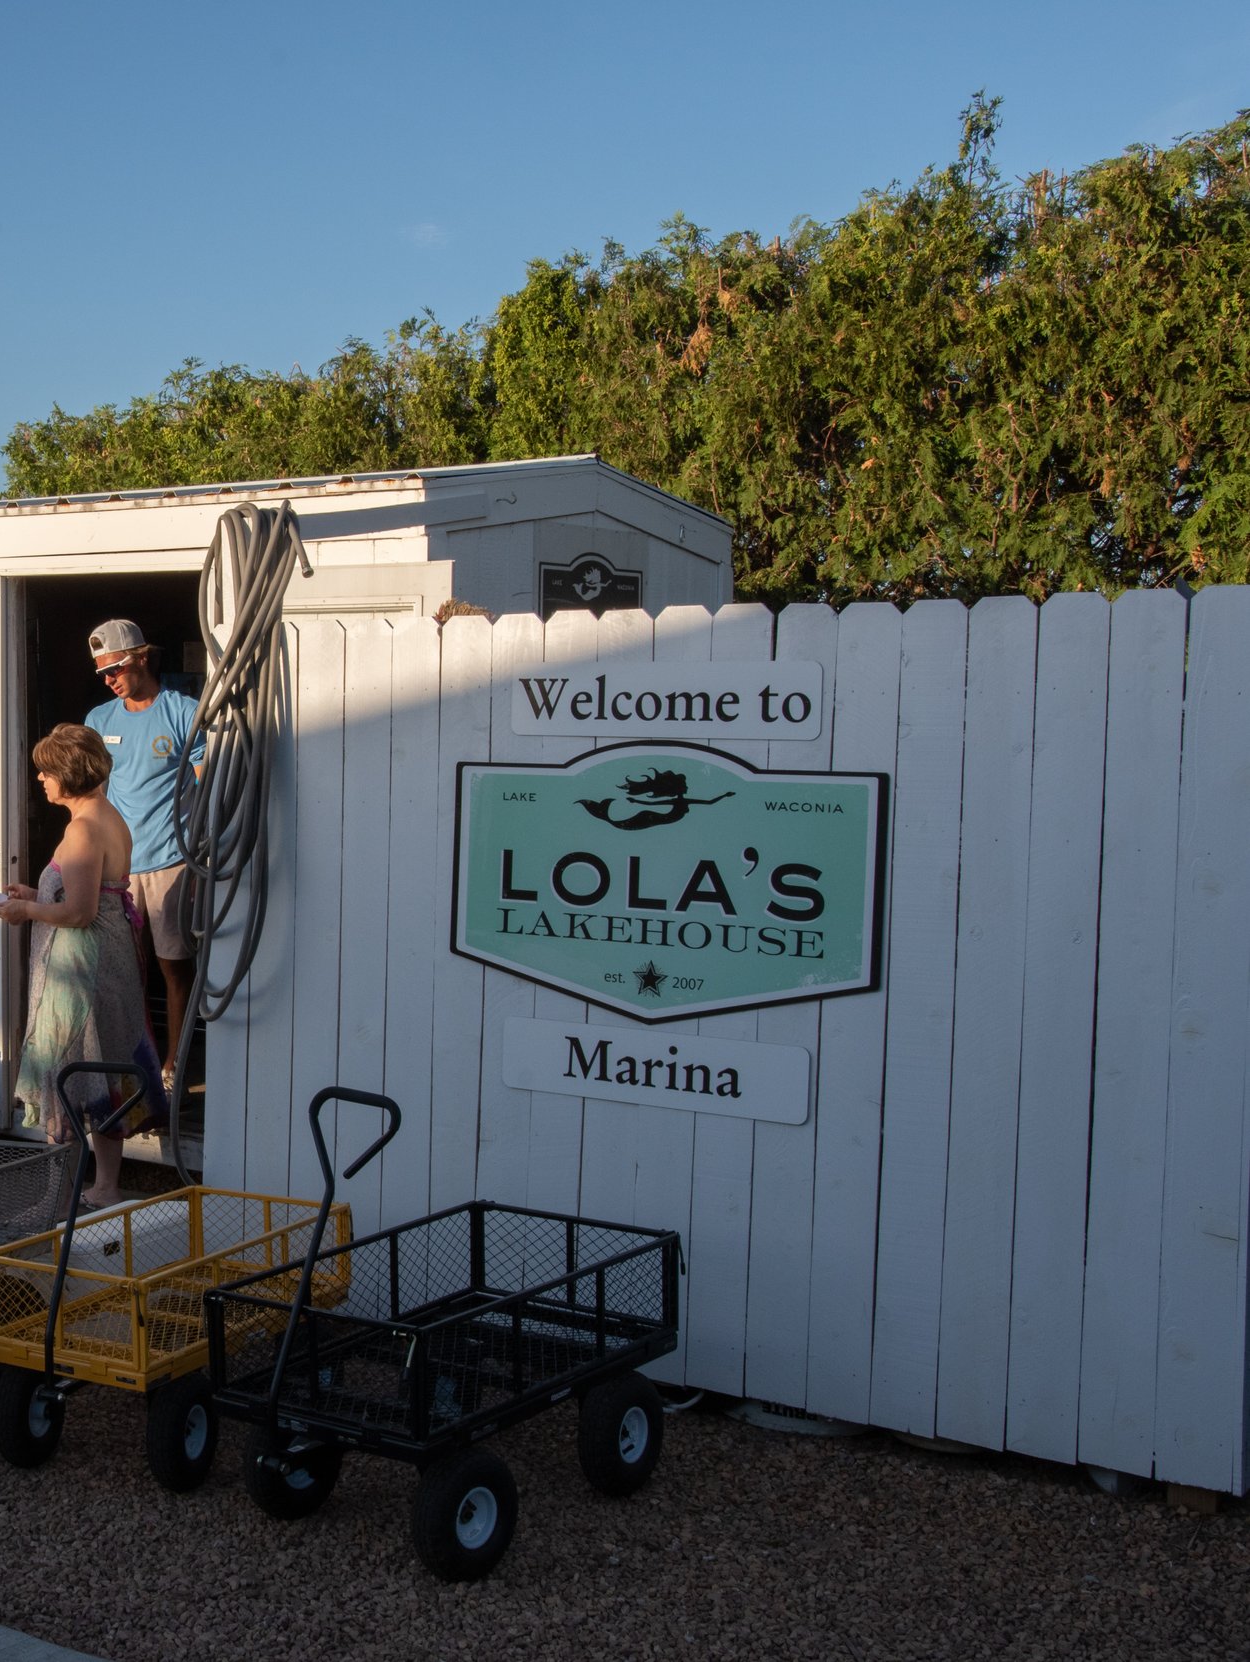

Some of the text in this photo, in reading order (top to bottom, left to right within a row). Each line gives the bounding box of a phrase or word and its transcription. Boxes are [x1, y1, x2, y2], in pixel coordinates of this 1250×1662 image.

[518, 674, 812, 724] Welcome to
[502, 792, 844, 814] LAKE WACONIA
[501, 846, 826, 922] LOLA'S
[496, 908, 824, 959] LAKEHOUSE
[604, 971, 704, 991] est. 2007
[563, 1036, 742, 1099] Marina
